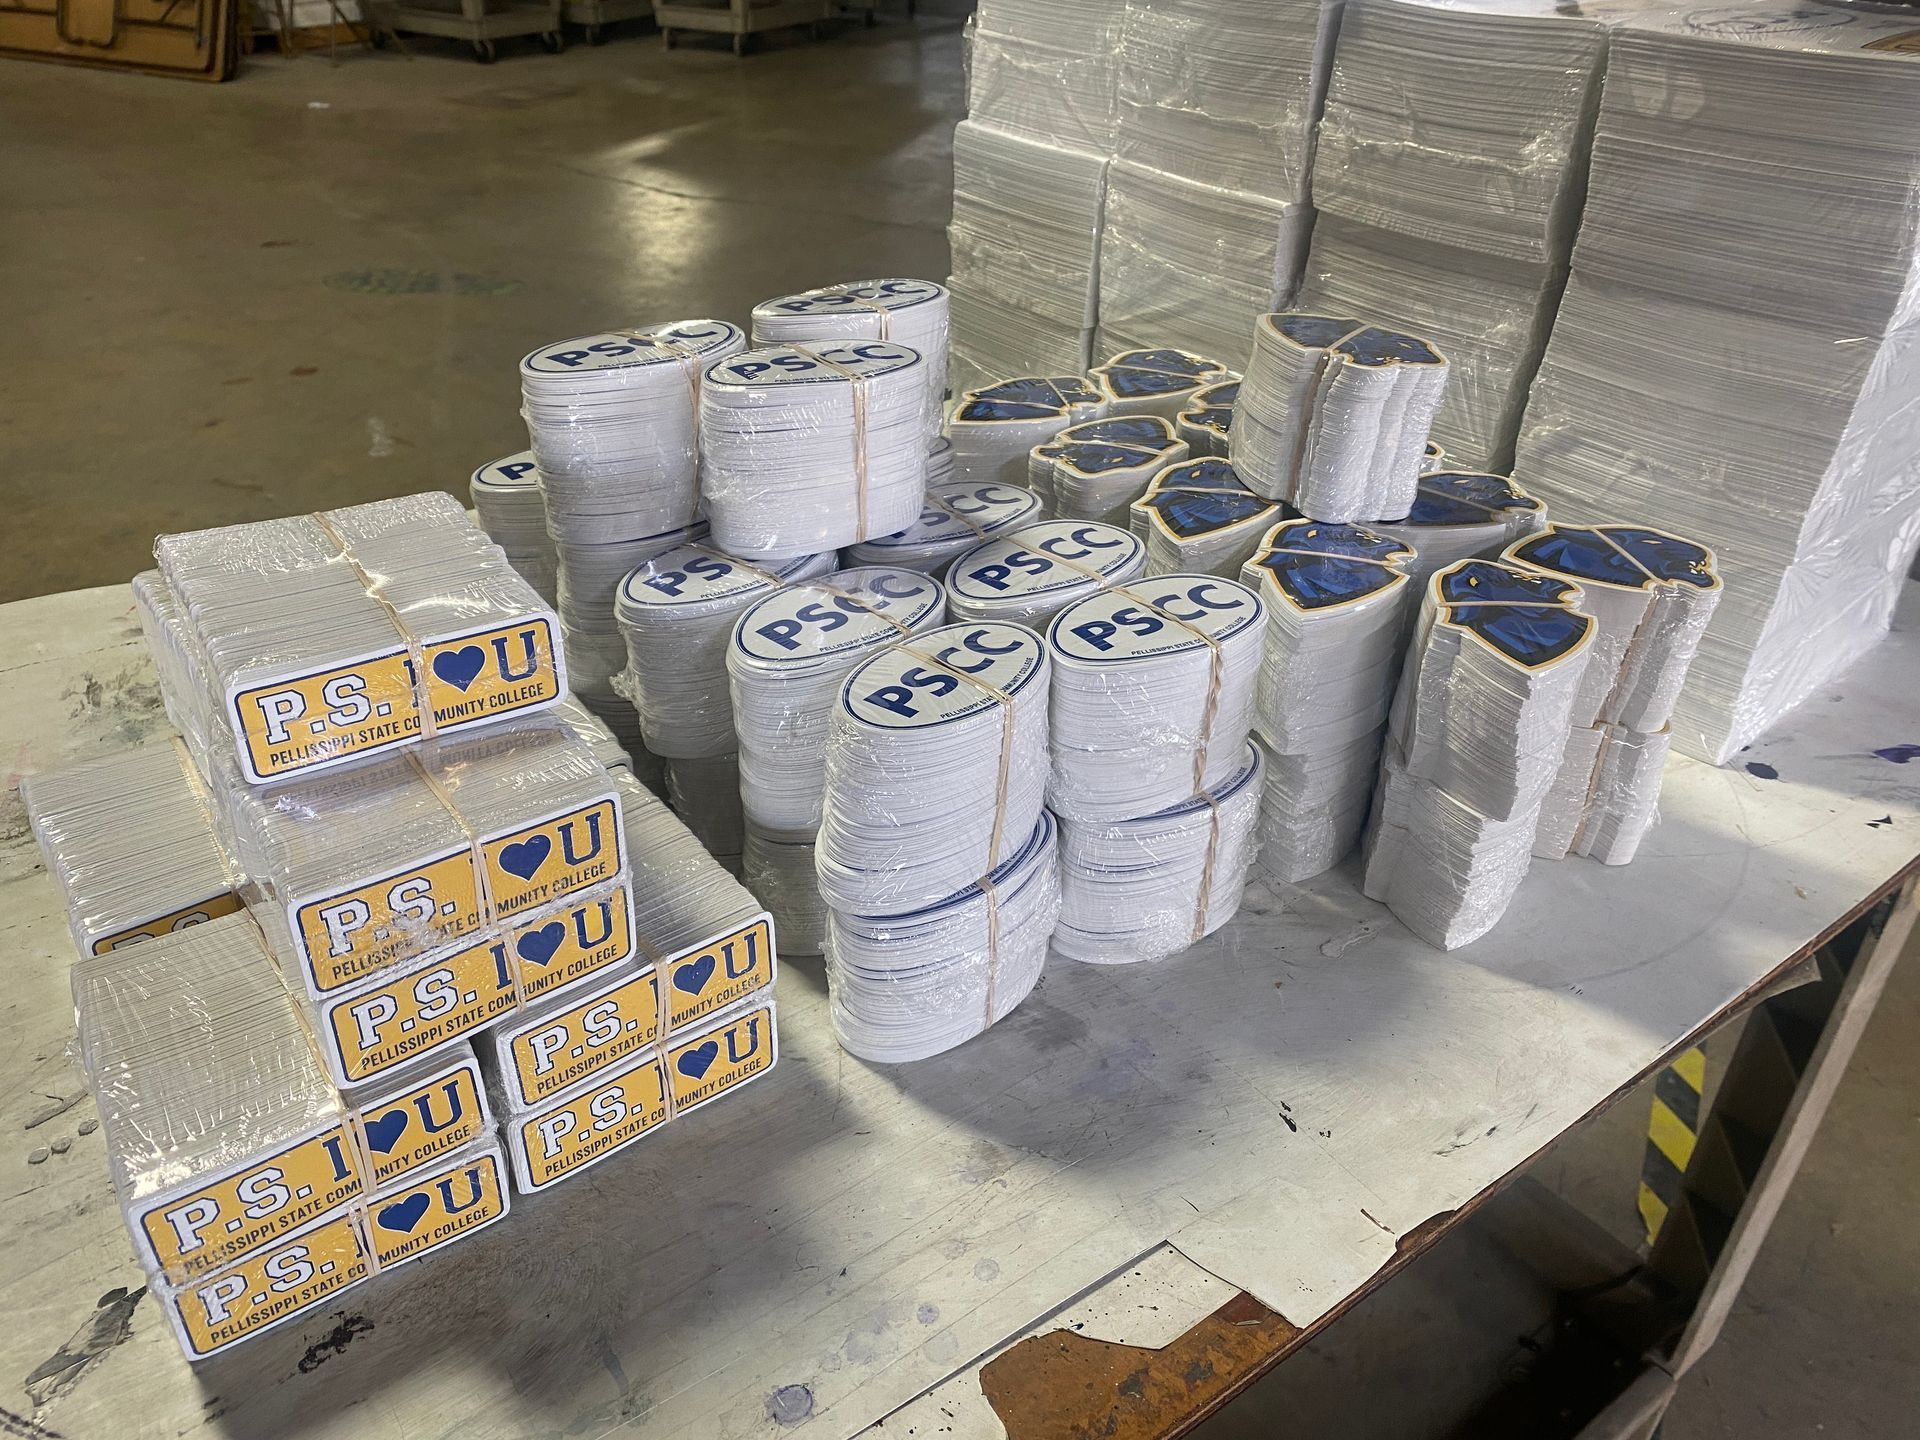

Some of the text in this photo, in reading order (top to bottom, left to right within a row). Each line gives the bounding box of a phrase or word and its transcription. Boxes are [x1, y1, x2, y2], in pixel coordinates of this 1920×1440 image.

[727, 345, 905, 380] PSCC
[890, 487, 1022, 538] SCC
[967, 527, 1123, 590] PSCC
[863, 629, 1024, 718] PSCC
[1069, 584, 1244, 651] PSCC
[1174, 640, 1194, 650] STATE
[256, 674, 392, 746] P.S.
[490, 629, 537, 682] U
[270, 683, 544, 767] PELLISSIPPI STATE COMUNITY COLLEGE
[319, 876, 456, 958] P.S.
[557, 811, 601, 866] U
[552, 861, 607, 893] COLLEGE
[351, 897, 613, 1051] P.S. I U
[361, 944, 618, 1071] PELLISSIPPI STATE COMUNITY COLLEGE
[528, 931, 757, 1076] P.S. U
[537, 1052, 607, 1093] PELLISSIPPI
[610, 1032, 644, 1057] STATE
[716, 973, 761, 1004] COLLEGE
[538, 1086, 643, 1160] P.S.
[724, 1017, 759, 1063] U
[545, 1057, 762, 1177] PELLISSIPPI STATE COMUNITY COLLEGE
[165, 1080, 463, 1255] P.S. I U
[184, 1221, 275, 1275] PELLISSIPPI
[280, 1198, 323, 1228] STATE
[414, 1124, 471, 1161] COLLEGE
[198, 1245, 335, 1328] P.S.
[436, 1167, 483, 1214] U
[210, 1206, 490, 1344] PELLISSIPPI STATE COMUNITY COLLEGE
